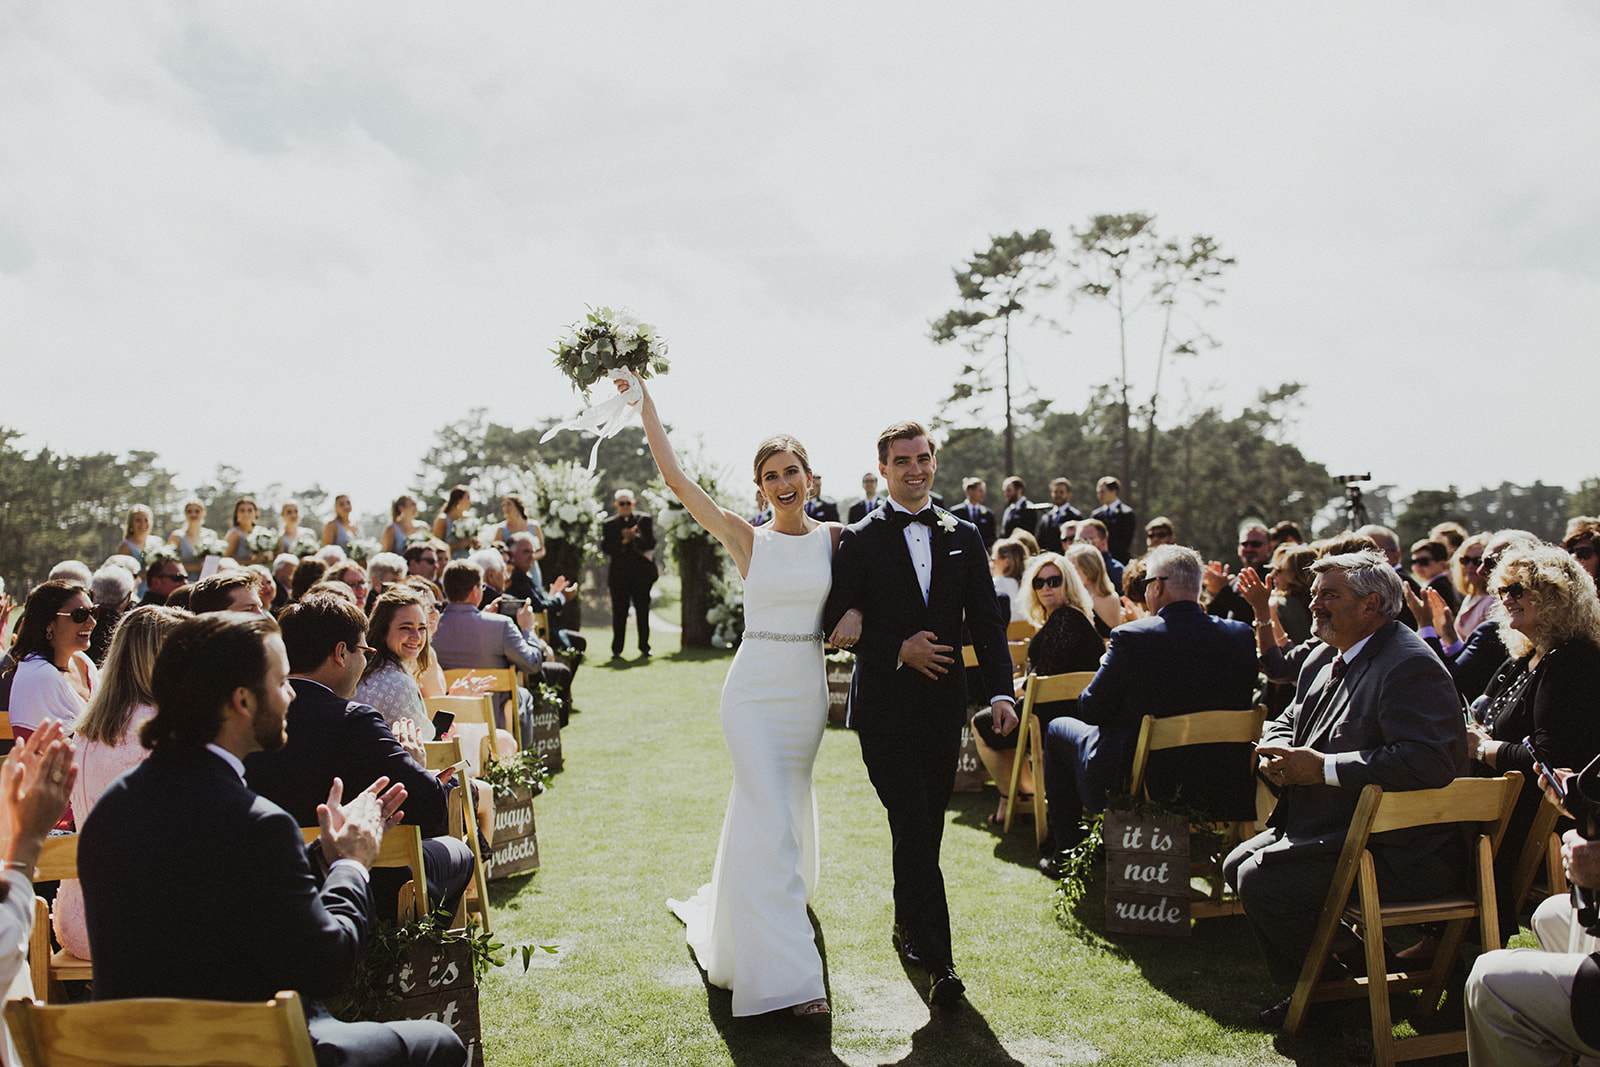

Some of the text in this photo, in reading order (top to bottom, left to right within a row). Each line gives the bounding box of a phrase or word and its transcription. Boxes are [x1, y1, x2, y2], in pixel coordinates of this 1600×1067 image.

[495, 807, 532, 834] ways
[1122, 825, 1173, 851] it is
[486, 837, 535, 879] protects
[1123, 862, 1169, 884] not
[1115, 897, 1181, 923] rude
